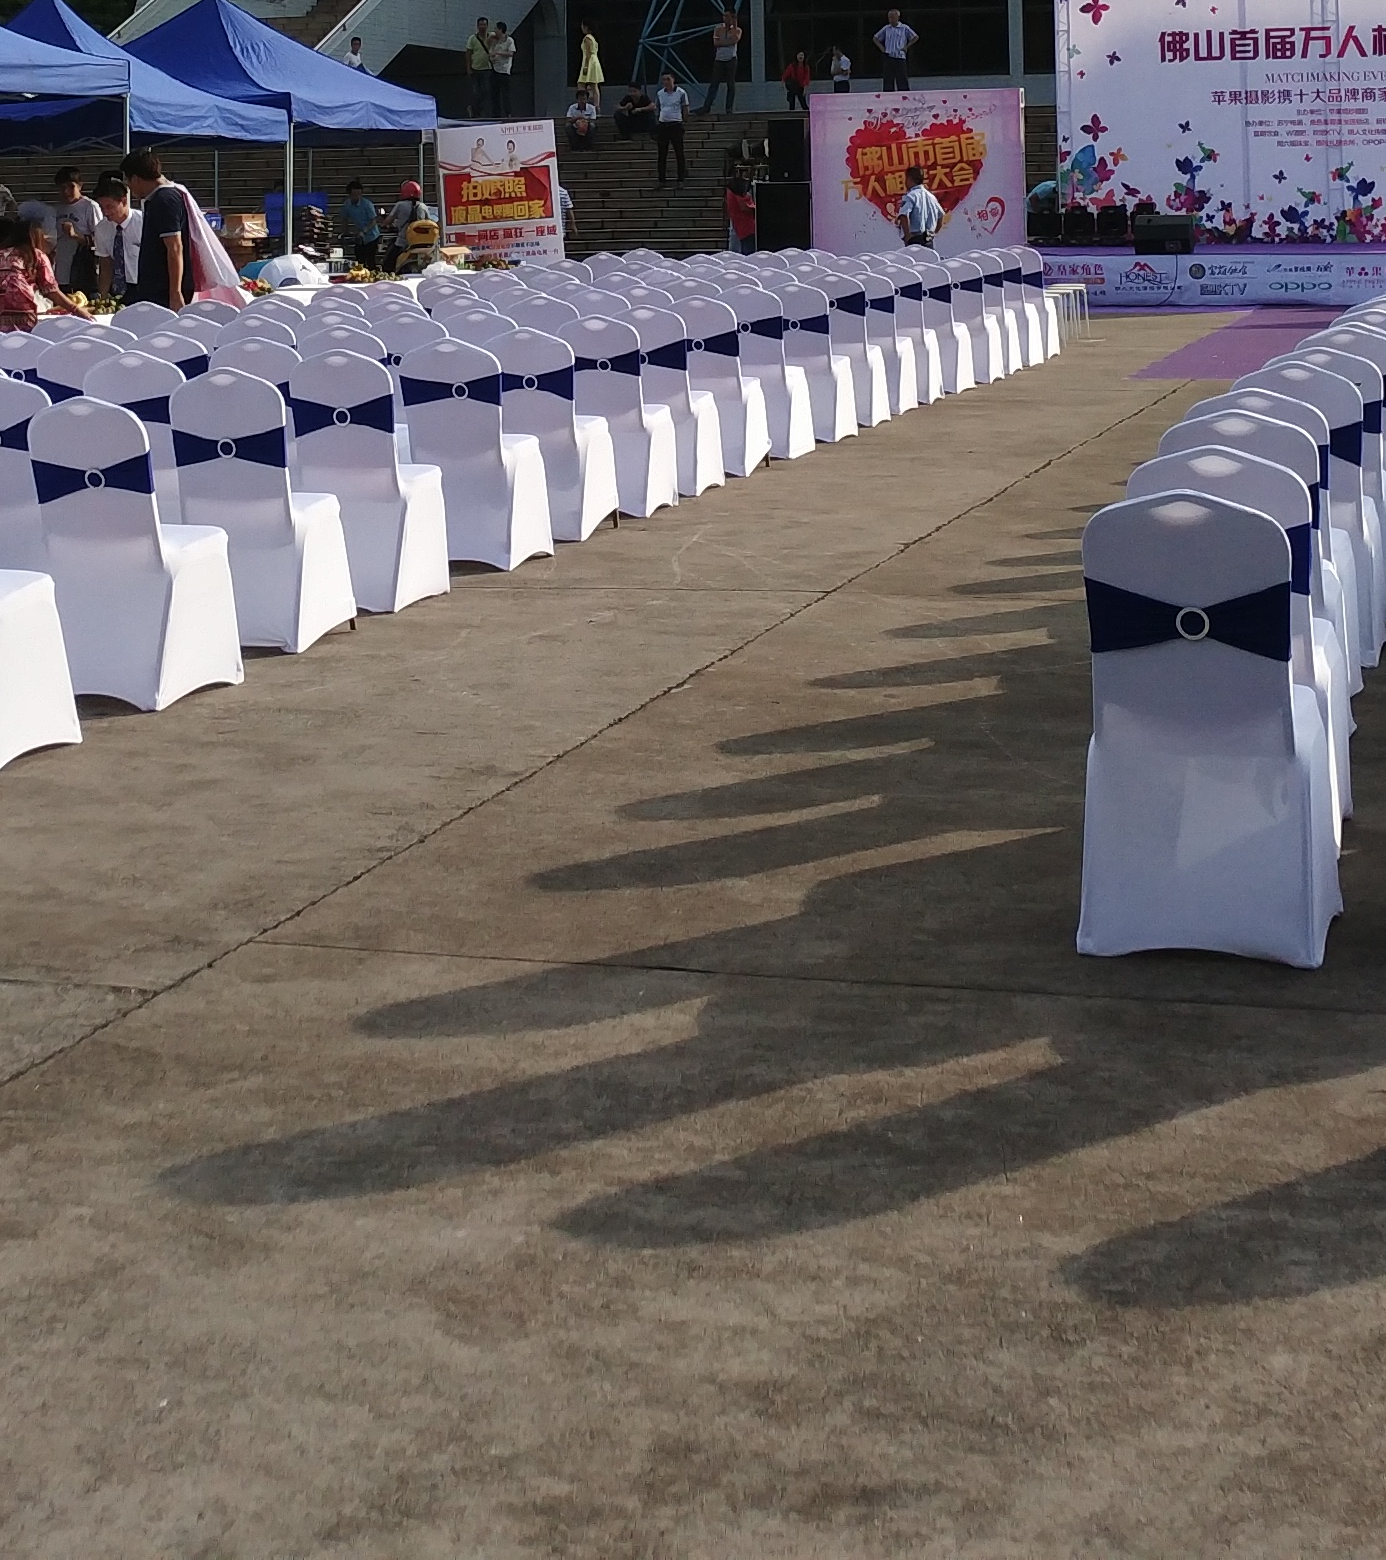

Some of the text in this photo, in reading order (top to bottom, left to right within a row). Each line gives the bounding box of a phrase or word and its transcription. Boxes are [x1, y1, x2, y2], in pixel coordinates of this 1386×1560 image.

[1264, 71, 1361, 84] MATCHMAKING
[855, 132, 987, 177] 佛山市首届
[841, 162, 974, 202] 万人相大会
